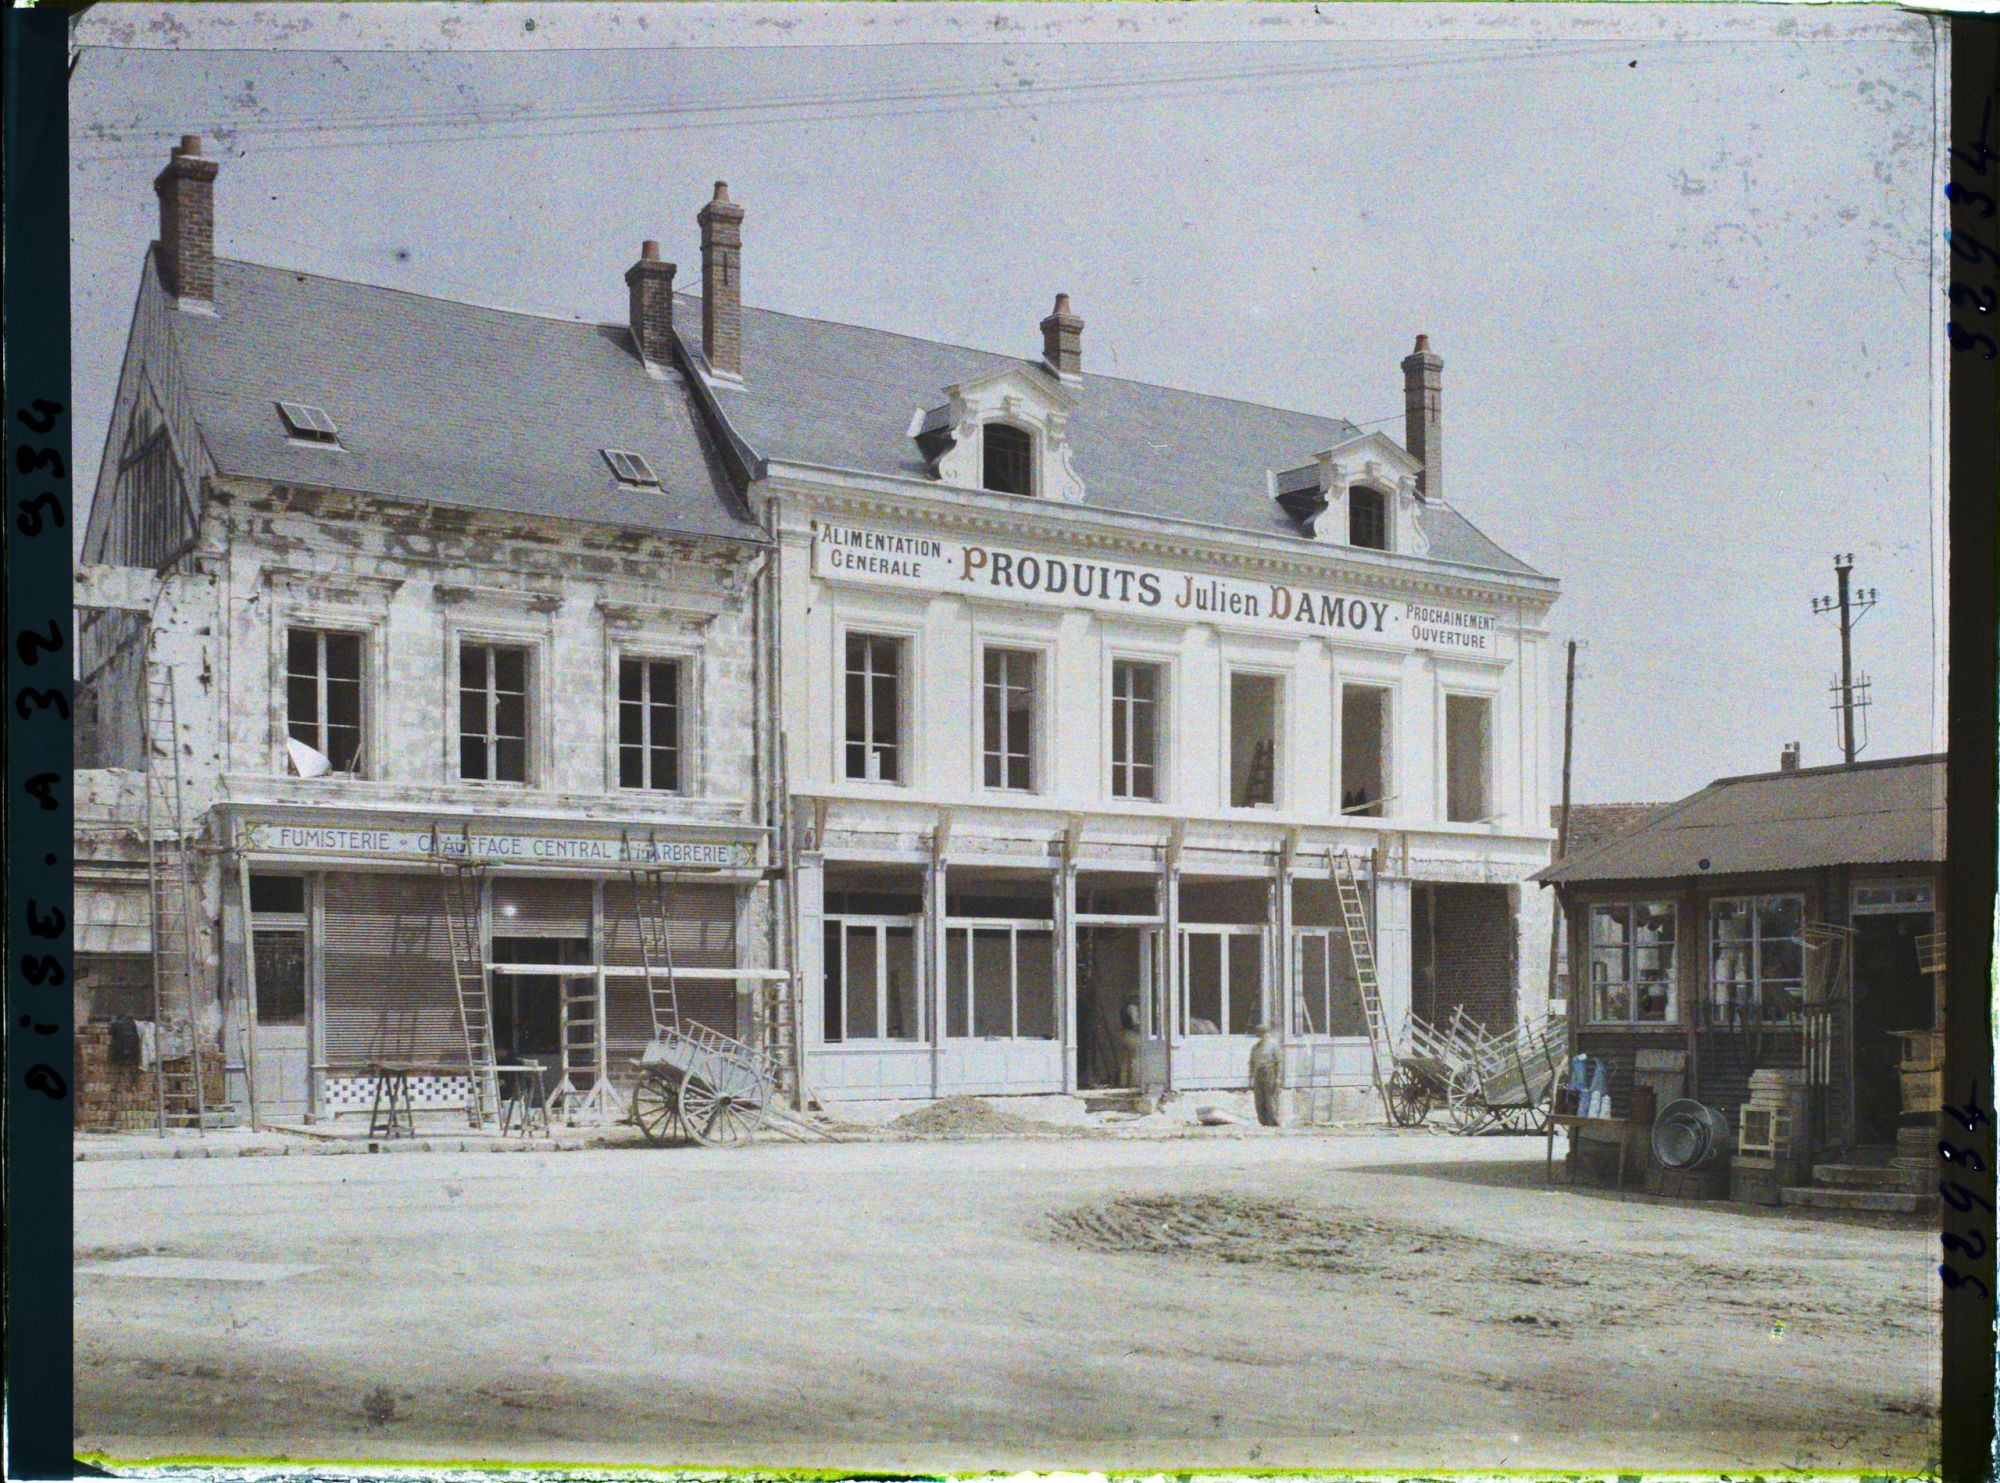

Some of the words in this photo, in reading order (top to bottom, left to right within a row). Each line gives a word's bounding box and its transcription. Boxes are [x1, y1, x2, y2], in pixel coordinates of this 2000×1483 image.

[821, 523, 941, 559] ALIMENTATION
[960, 546, 1162, 607] PRODUITS
[1175, 575, 1259, 617] Julien
[1268, 584, 1389, 633] DAMOY
[1406, 603, 1495, 631] PROCHAINEMENT
[1411, 624, 1485, 649] OUVERTURE
[280, 829, 390, 850] FUMISTERIE
[533, 838, 612, 859] CENTRAL
